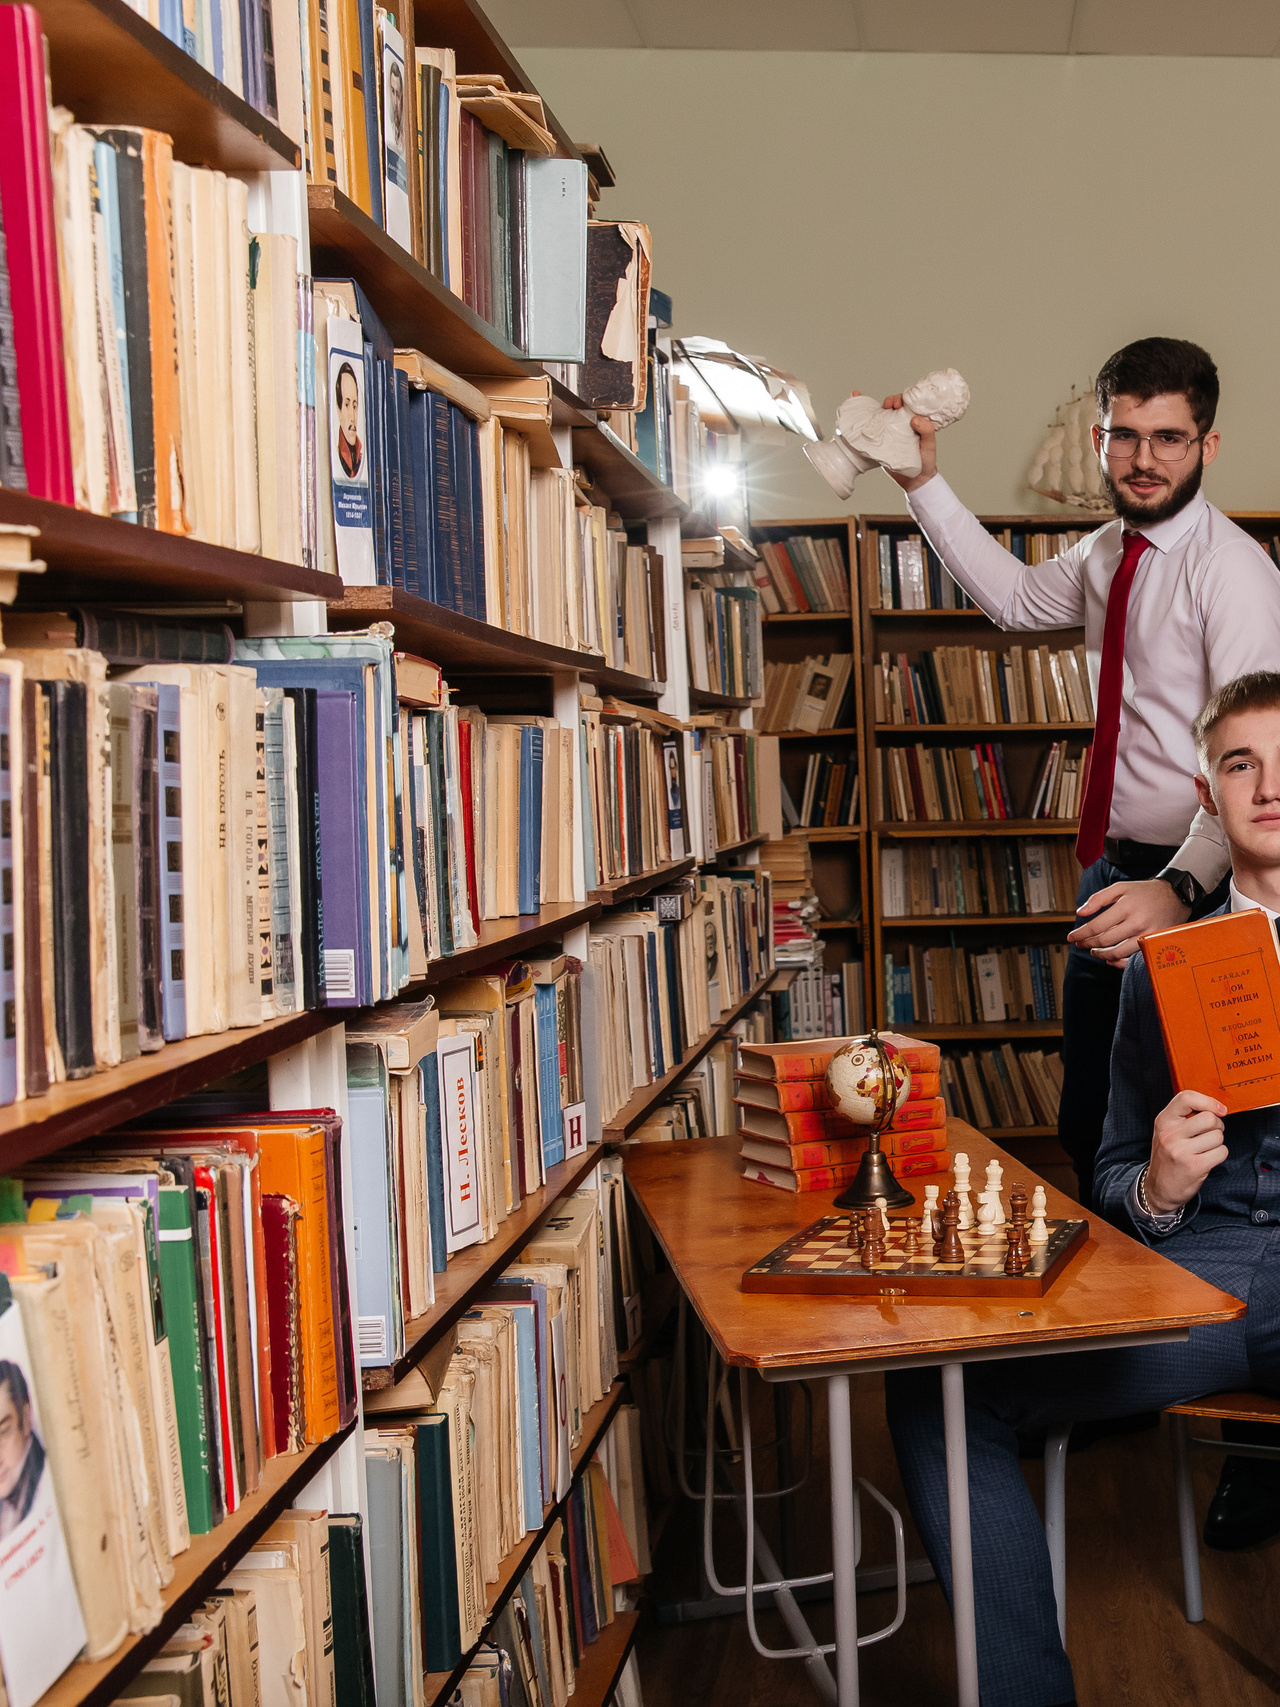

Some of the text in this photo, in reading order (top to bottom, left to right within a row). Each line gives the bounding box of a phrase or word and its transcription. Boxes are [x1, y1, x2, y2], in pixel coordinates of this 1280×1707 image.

[218, 749, 227, 814] ГОГОЛЬ
[244, 826, 254, 871] ГОГОЛЬ
[245, 894, 255, 944] МЕРТВЫЕ
[246, 952, 256, 985] ДУШИ
[1157, 959, 1187, 970] ПИОНЕРА
[1208, 992, 1260, 1009] ТОВАРИЩИ
[1227, 1053, 1274, 1070] ВОЖАТЫМ
[1244, 1044, 1263, 1053] БЫЛ
[455, 1077, 471, 1202] Н. Лесков
[568, 1115, 583, 1150] Н
[168, 1424, 185, 1517] ГРИБОЕДОВ
